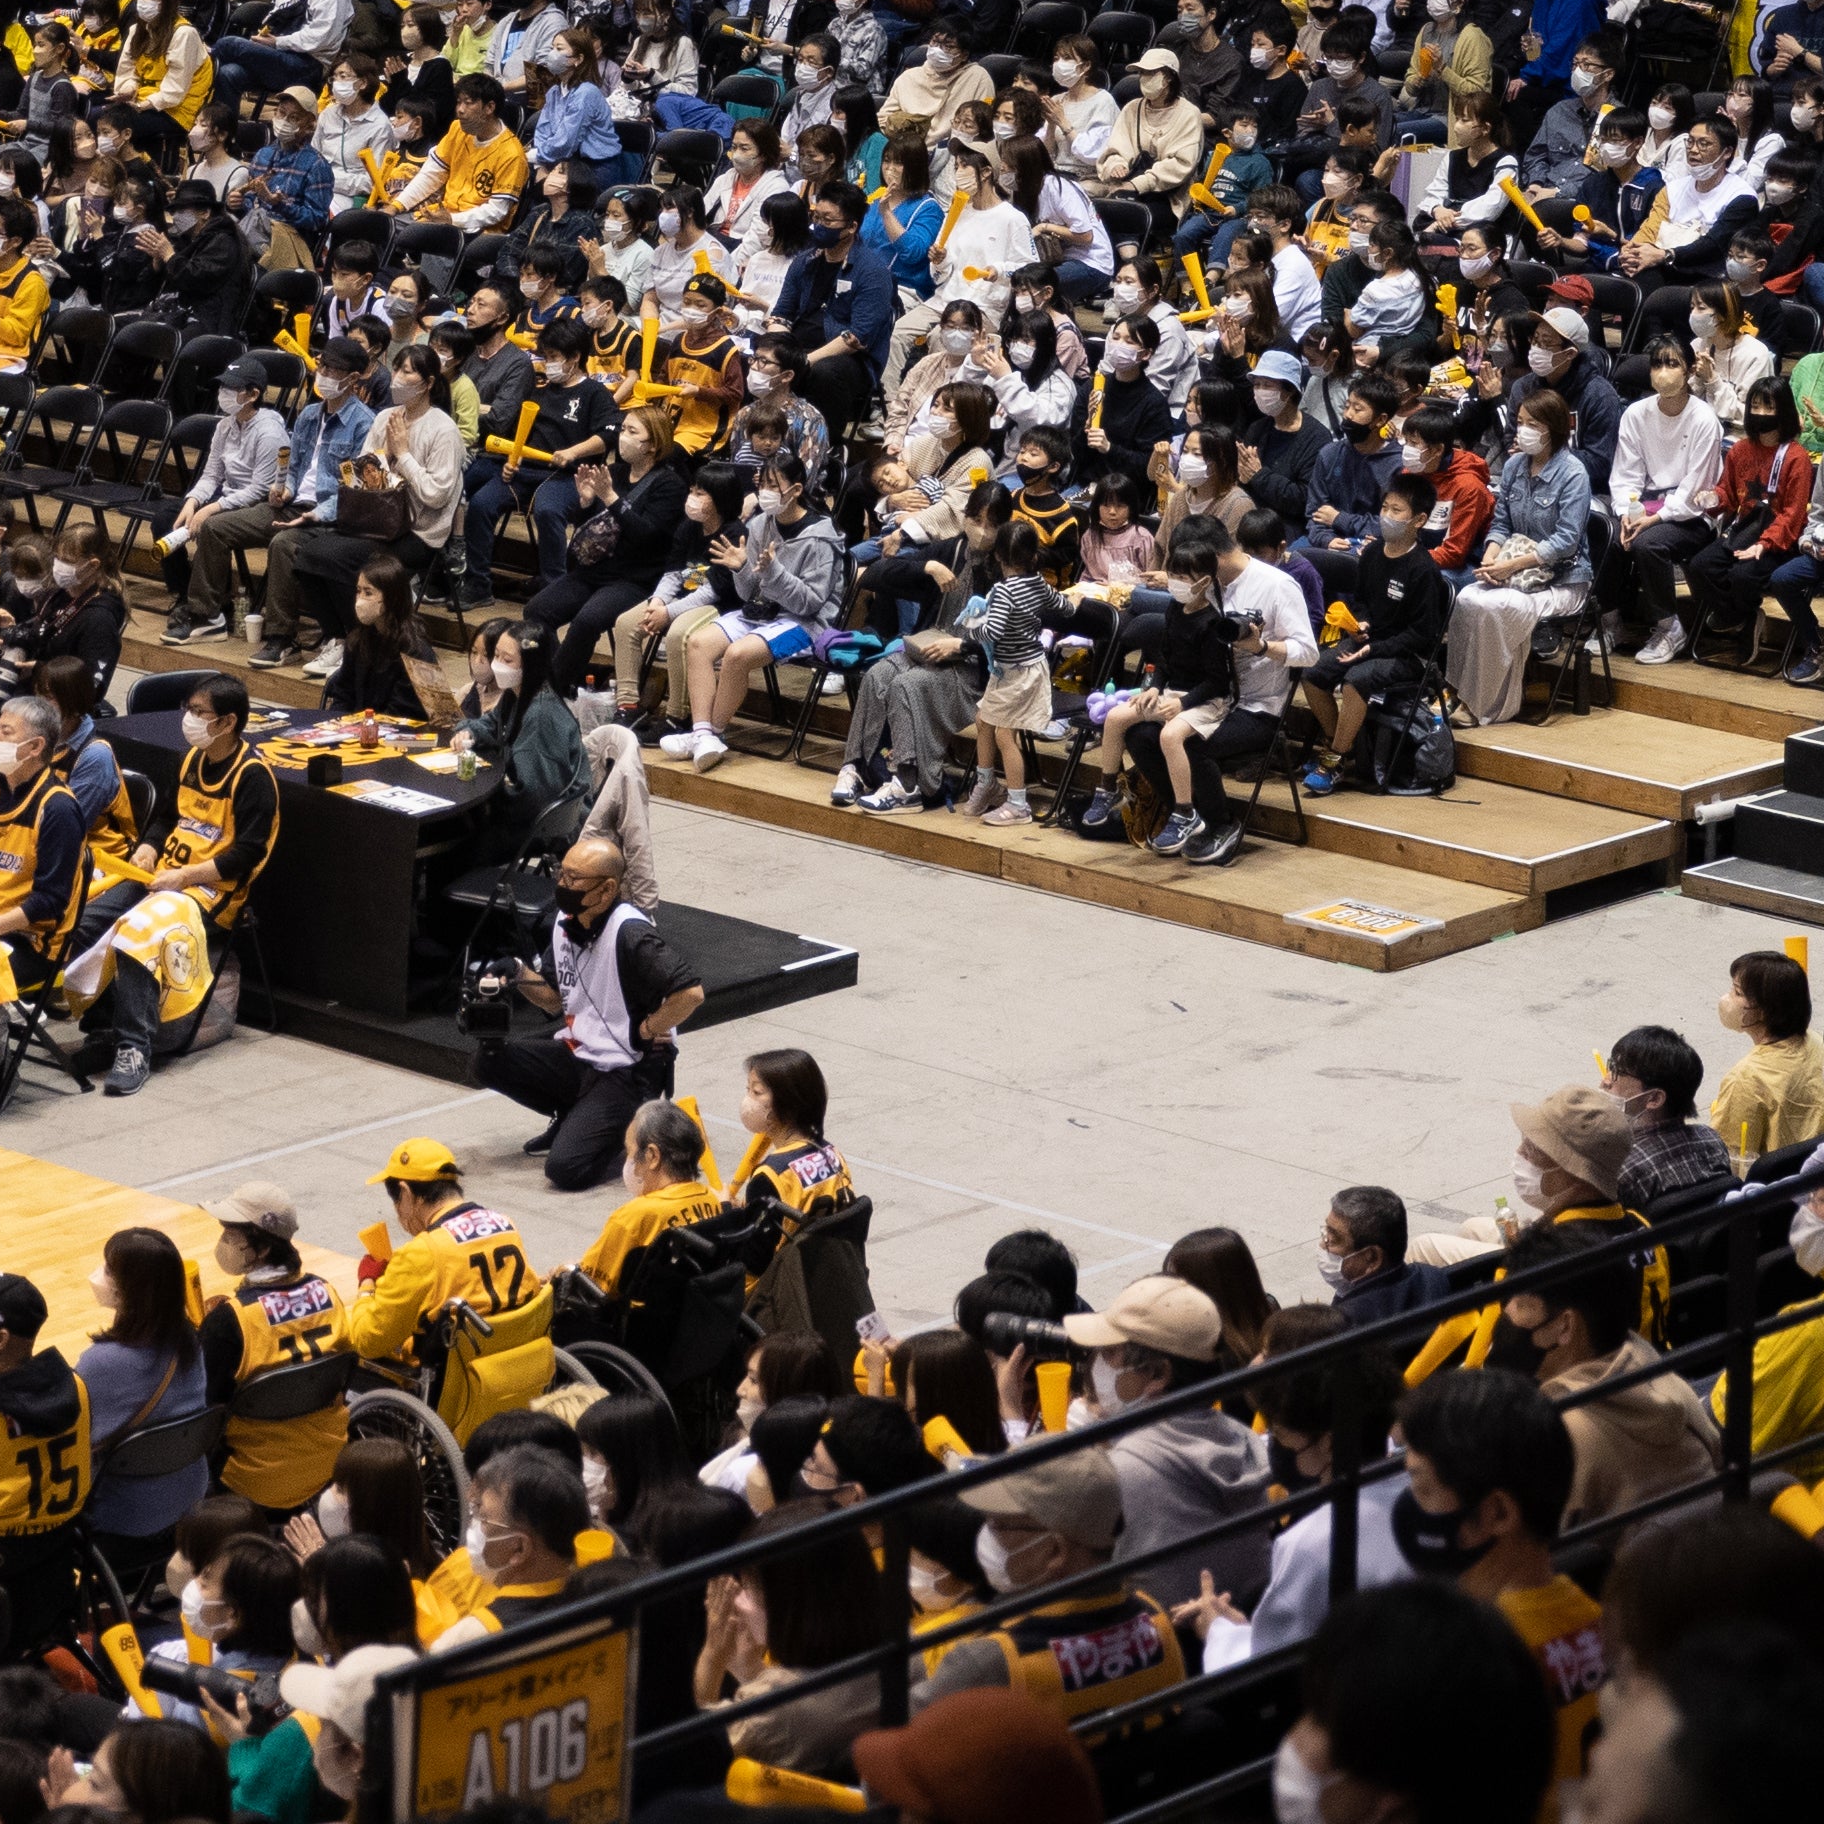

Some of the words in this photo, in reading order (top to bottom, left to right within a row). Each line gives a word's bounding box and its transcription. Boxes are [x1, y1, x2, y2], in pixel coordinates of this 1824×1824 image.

[265, 1280, 333, 1321] やまや
[469, 1242, 526, 1312] 12
[16, 1432, 80, 1521] 15
[1057, 1619, 1165, 1690] やまや
[1544, 1631, 1604, 1704] やま
[463, 1697, 588, 1811] A106
